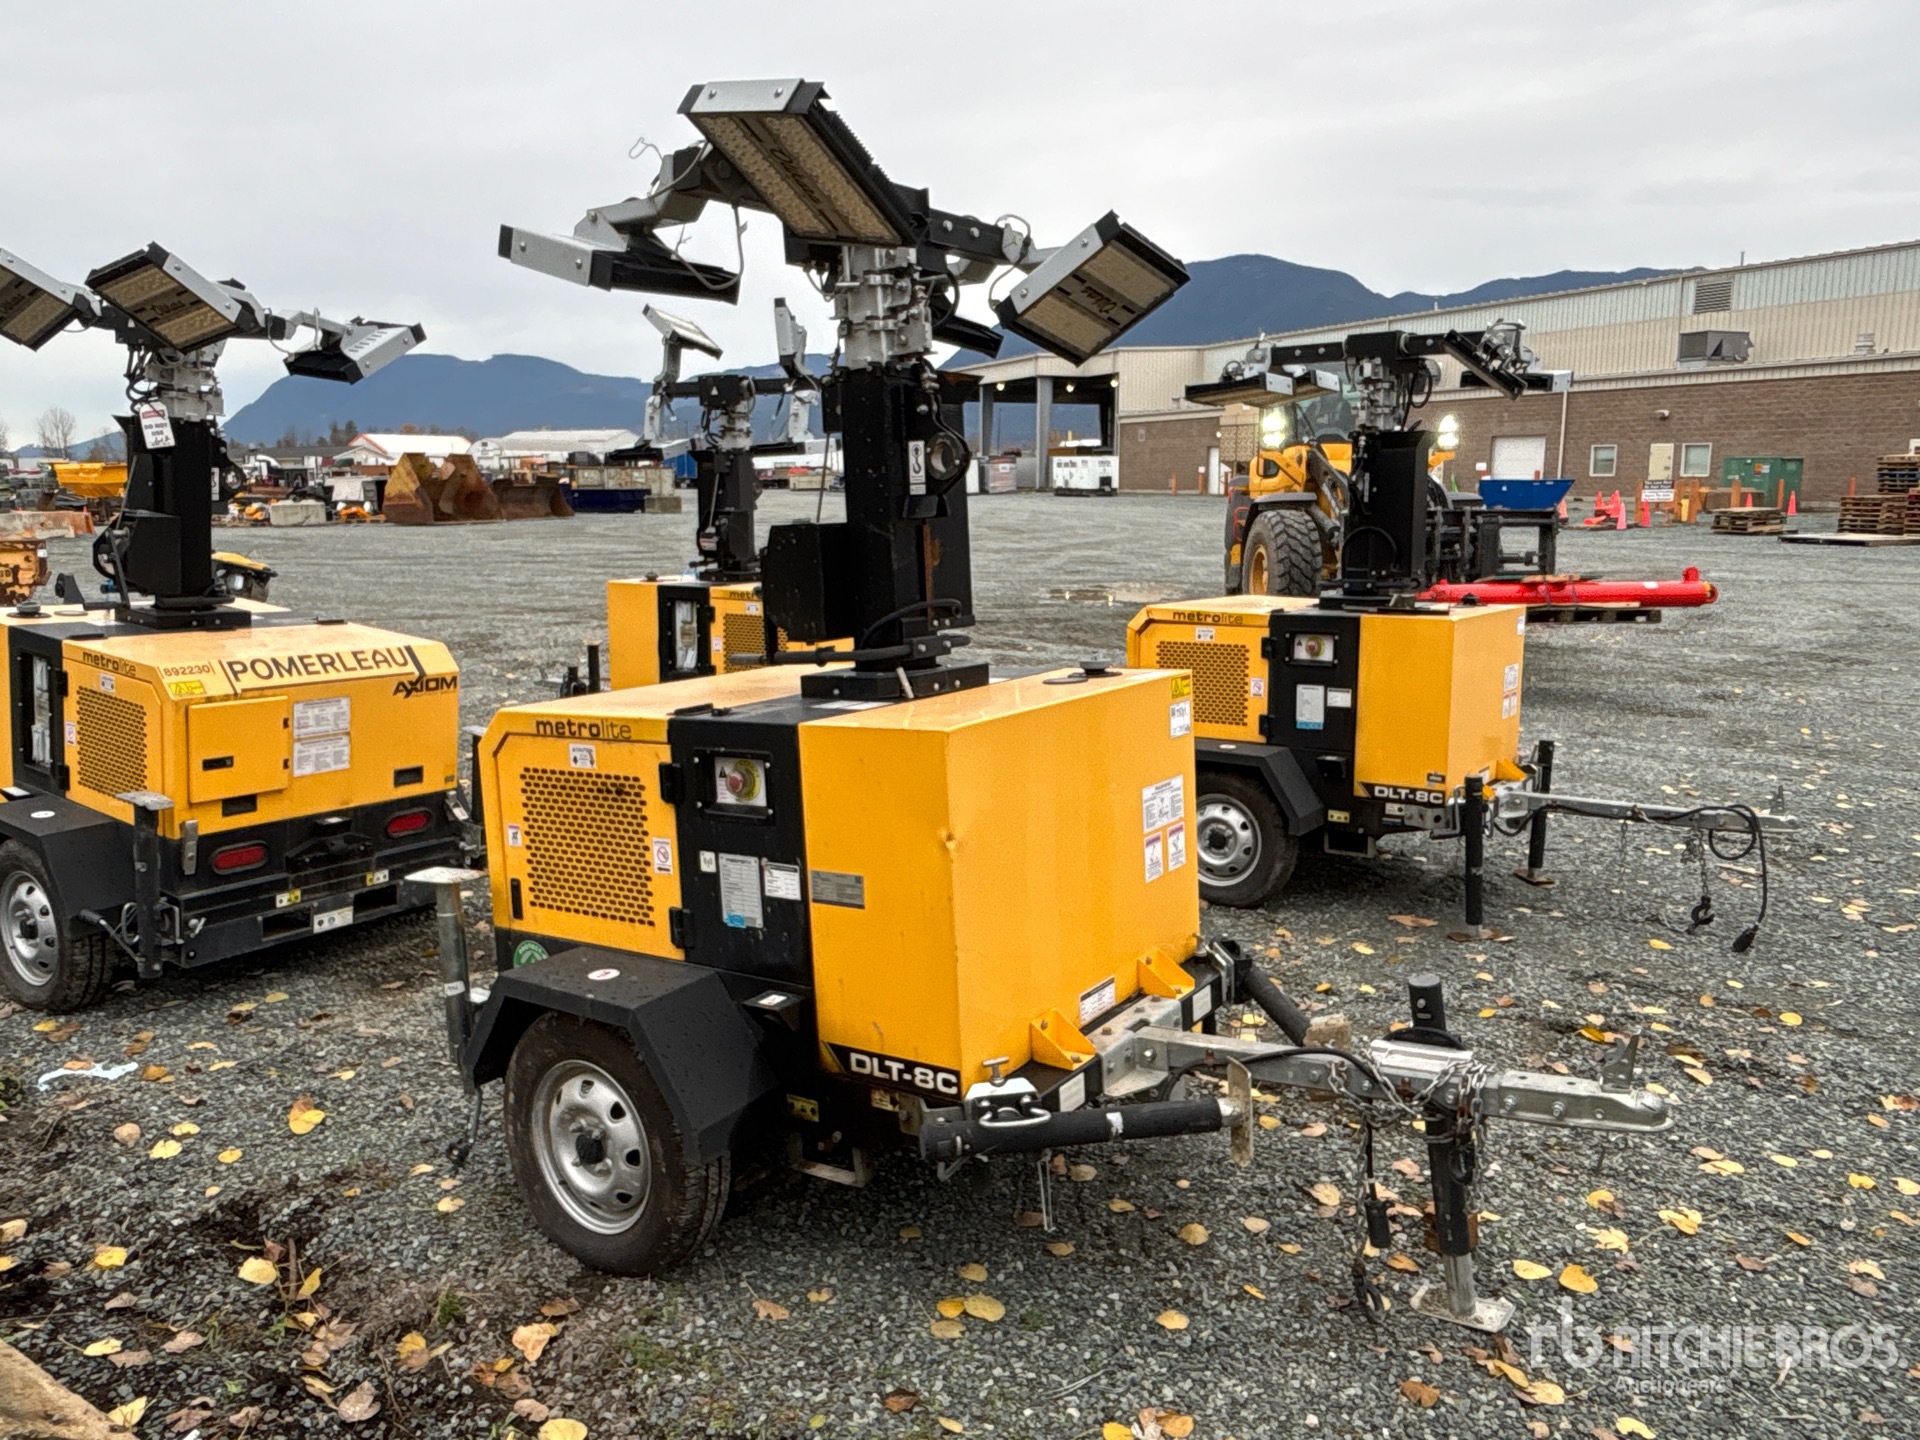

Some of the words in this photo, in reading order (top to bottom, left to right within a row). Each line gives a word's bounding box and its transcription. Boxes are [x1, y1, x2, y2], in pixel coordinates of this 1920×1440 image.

[1172, 611, 1244, 626] metrolite
[82, 651, 137, 677] metrolite
[163, 664, 211, 676] 892230
[226, 647, 409, 682] POMERLEAU
[393, 676, 458, 699] AXIOM
[535, 718, 633, 740] metrolite
[1374, 786, 1444, 805] DLT-8C
[849, 1050, 960, 1096] DLT-8C
